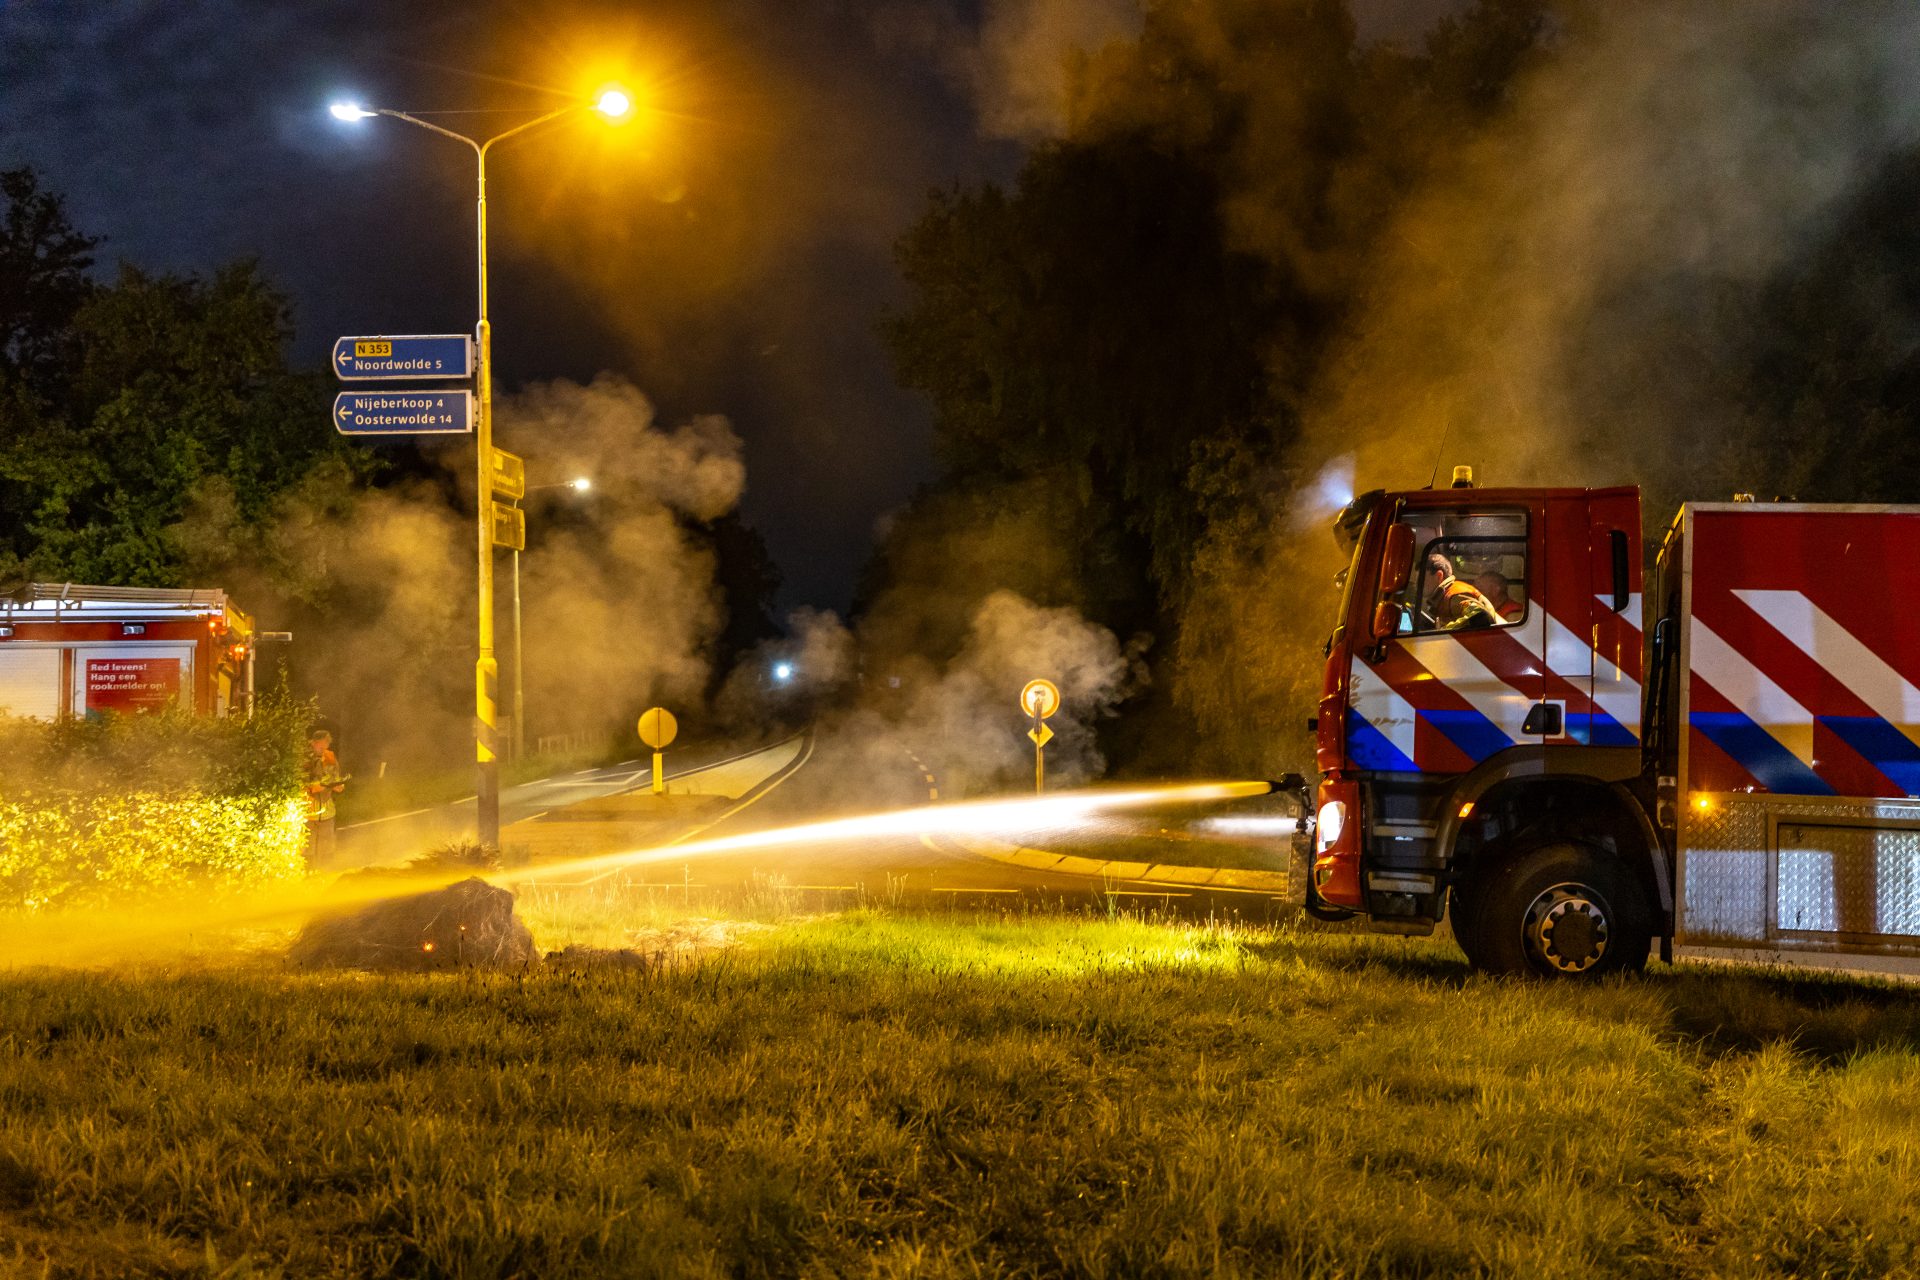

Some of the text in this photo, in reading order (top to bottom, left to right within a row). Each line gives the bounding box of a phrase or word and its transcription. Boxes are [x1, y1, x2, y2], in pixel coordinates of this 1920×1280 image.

[358, 345, 389, 354] N 353
[355, 359, 442, 370] Noordwolde 5
[355, 398, 443, 411] Nijeberkoop 4
[355, 413, 452, 425] Oosterwolde 14
[91, 673, 116, 682] Hang
[90, 682, 148, 690] rookmelder
